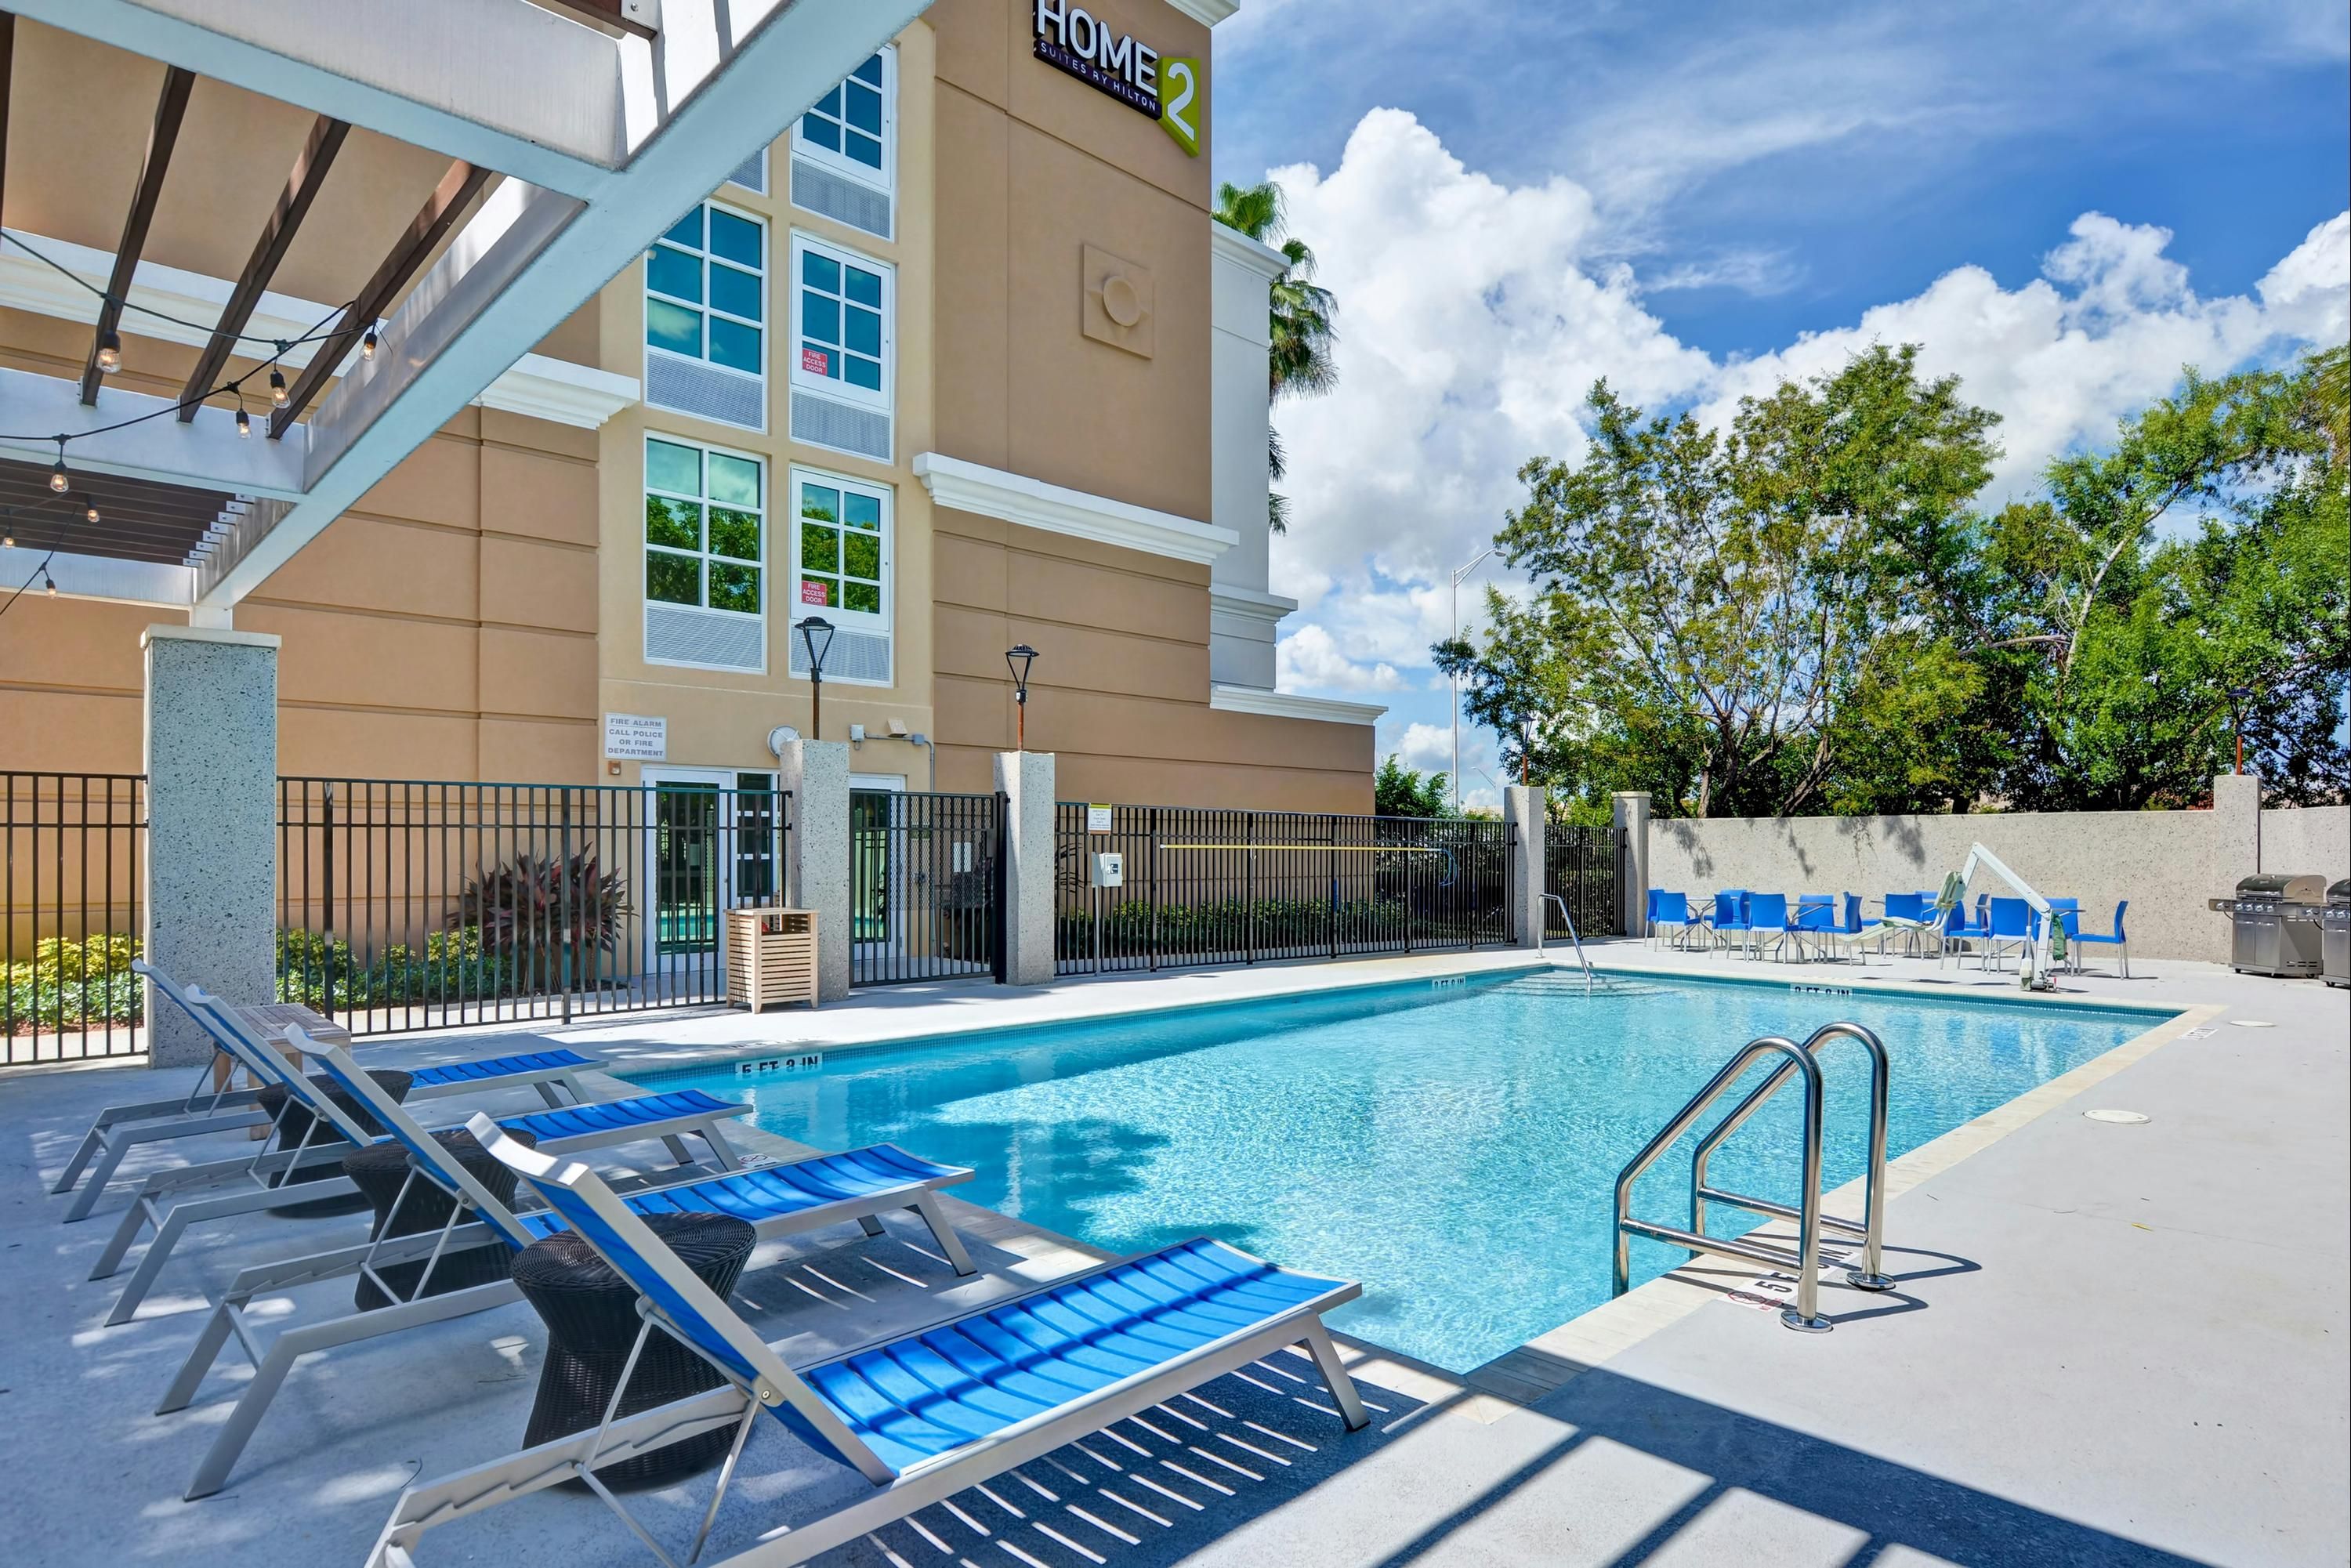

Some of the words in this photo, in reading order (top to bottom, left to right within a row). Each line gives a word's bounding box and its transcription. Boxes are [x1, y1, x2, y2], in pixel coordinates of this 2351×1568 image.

[1038, 0, 1158, 97] HOME
[1167, 62, 1195, 142] 2
[1041, 42, 1087, 74] SUITES
[1093, 71, 1107, 85] BY
[1113, 81, 1156, 111] HILTON
[808, 351, 821, 360] FIRE
[803, 357, 826, 368] ACCESS
[806, 364, 823, 373] DOOR
[802, 588, 826, 598] ACCESS
[608, 748, 664, 756] DEPARTMENT
[802, 1056, 818, 1066] IN
[1755, 1280, 1793, 1293] 5
